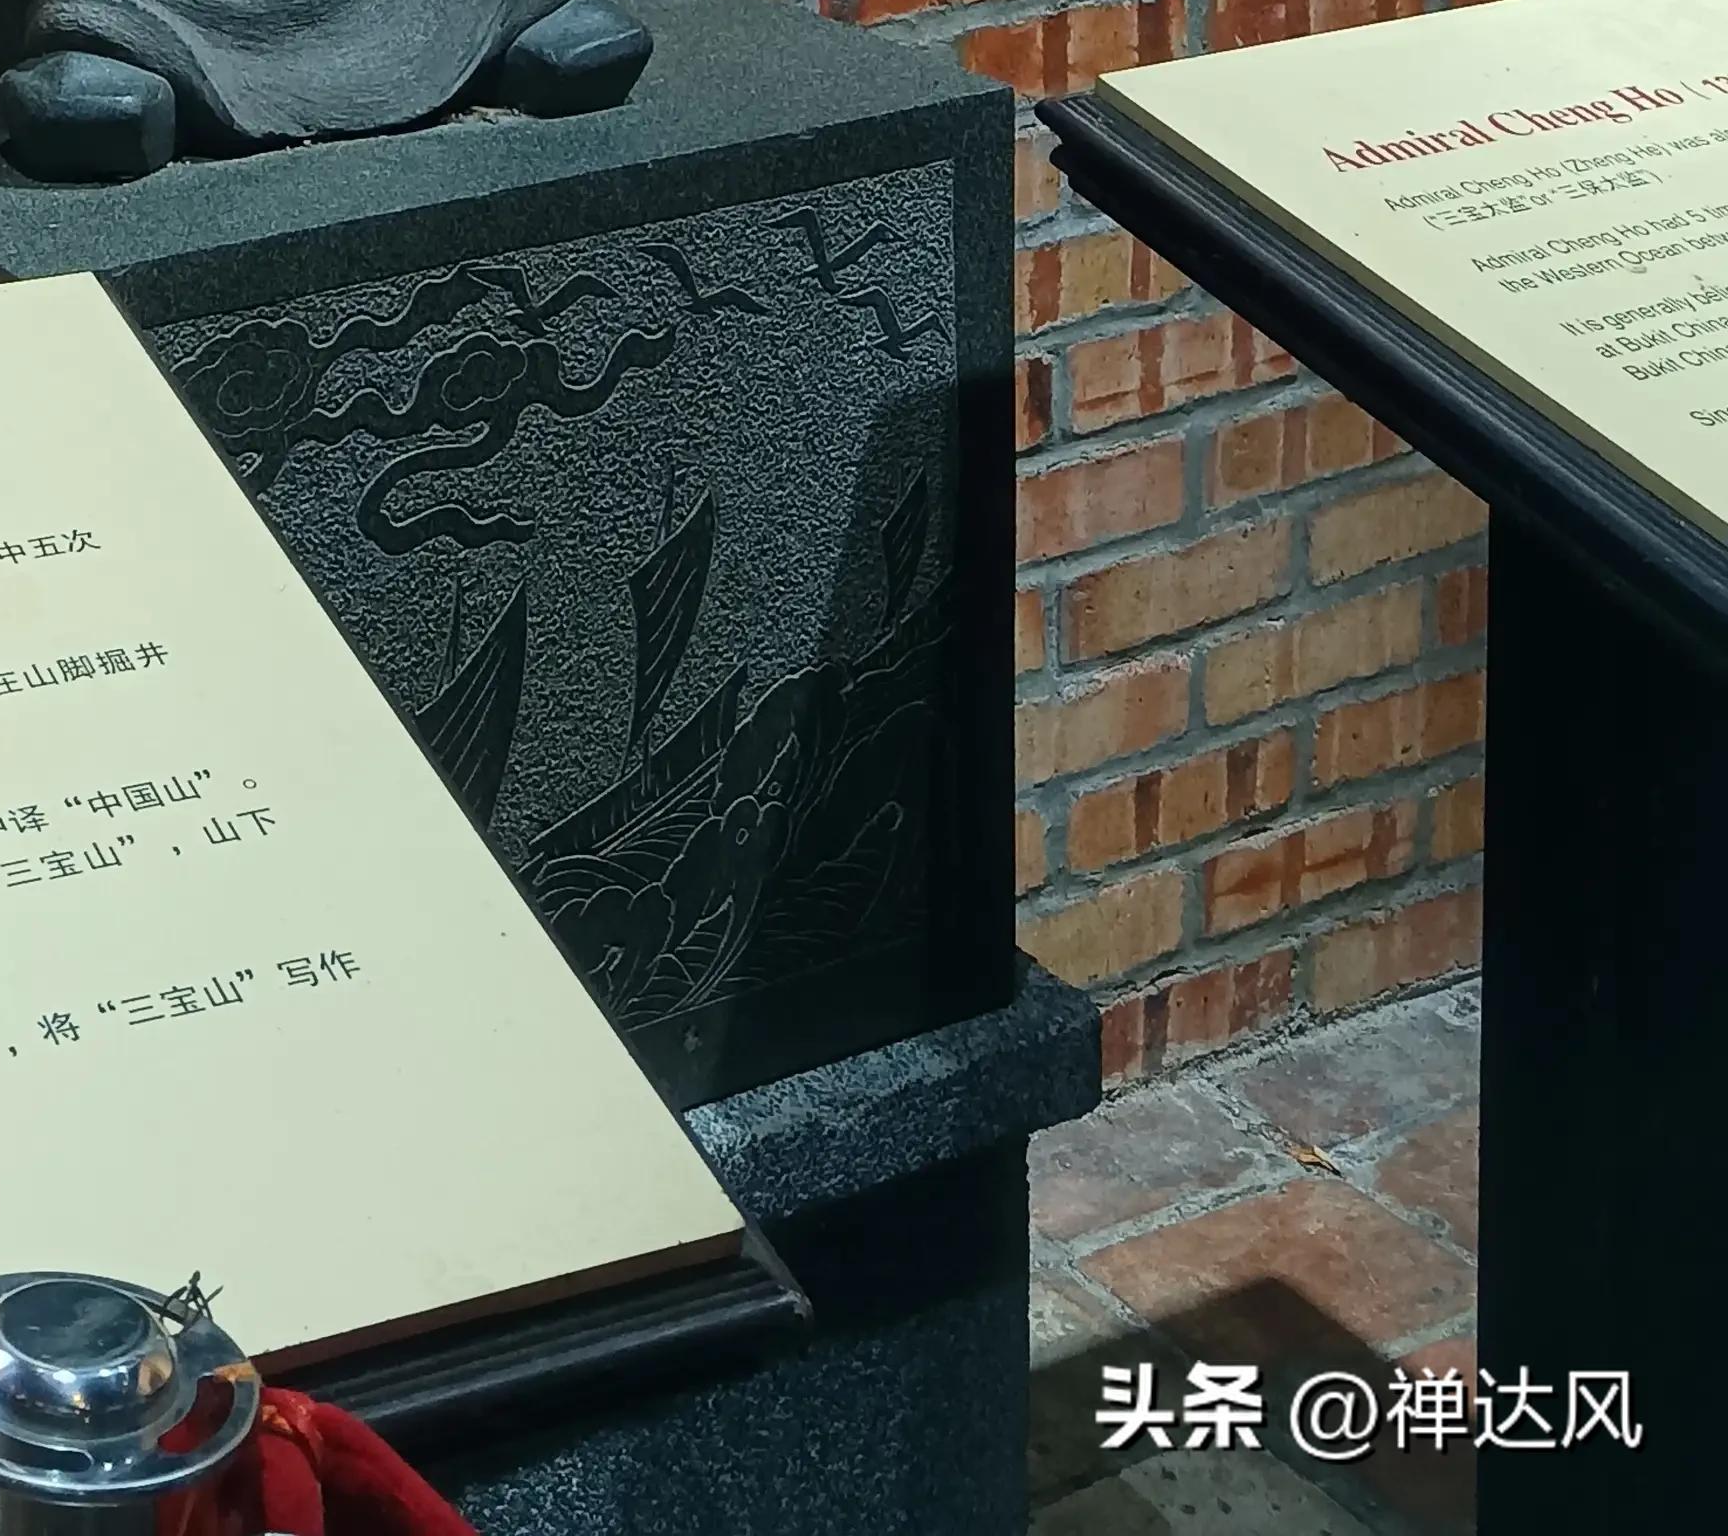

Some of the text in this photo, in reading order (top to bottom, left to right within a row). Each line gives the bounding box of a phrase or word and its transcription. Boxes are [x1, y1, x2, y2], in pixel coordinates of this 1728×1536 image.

[1323, 120, 1497, 173] Admiral
[1487, 101, 1633, 136] Cheng
[1608, 86, 1685, 112] Ho
[1384, 185, 1463, 212] Admiral
[1460, 172, 1534, 195] Cheng
[1526, 166, 1561, 180] Ho
[1559, 151, 1636, 176] (Zheng
[1626, 142, 1673, 159] He)
[1668, 135, 1710, 151] was
[1471, 246, 1552, 273] Admiral
[1546, 232, 1623, 255] Cheng
[1612, 224, 1650, 240] Ho
[1644, 214, 1691, 231] had
[1685, 209, 1707, 223] 5
[1498, 277, 1539, 294] the
[1535, 256, 1624, 285] Western
[1617, 242, 1691, 266] Ocean
[1559, 321, 1585, 336] It
[1575, 317, 1605, 333] is
[1602, 296, 1698, 330] generally
[1595, 343, 1624, 359] at
[1615, 328, 1678, 353] Bukit
[1622, 344, 1728, 381] Bukit Chin
